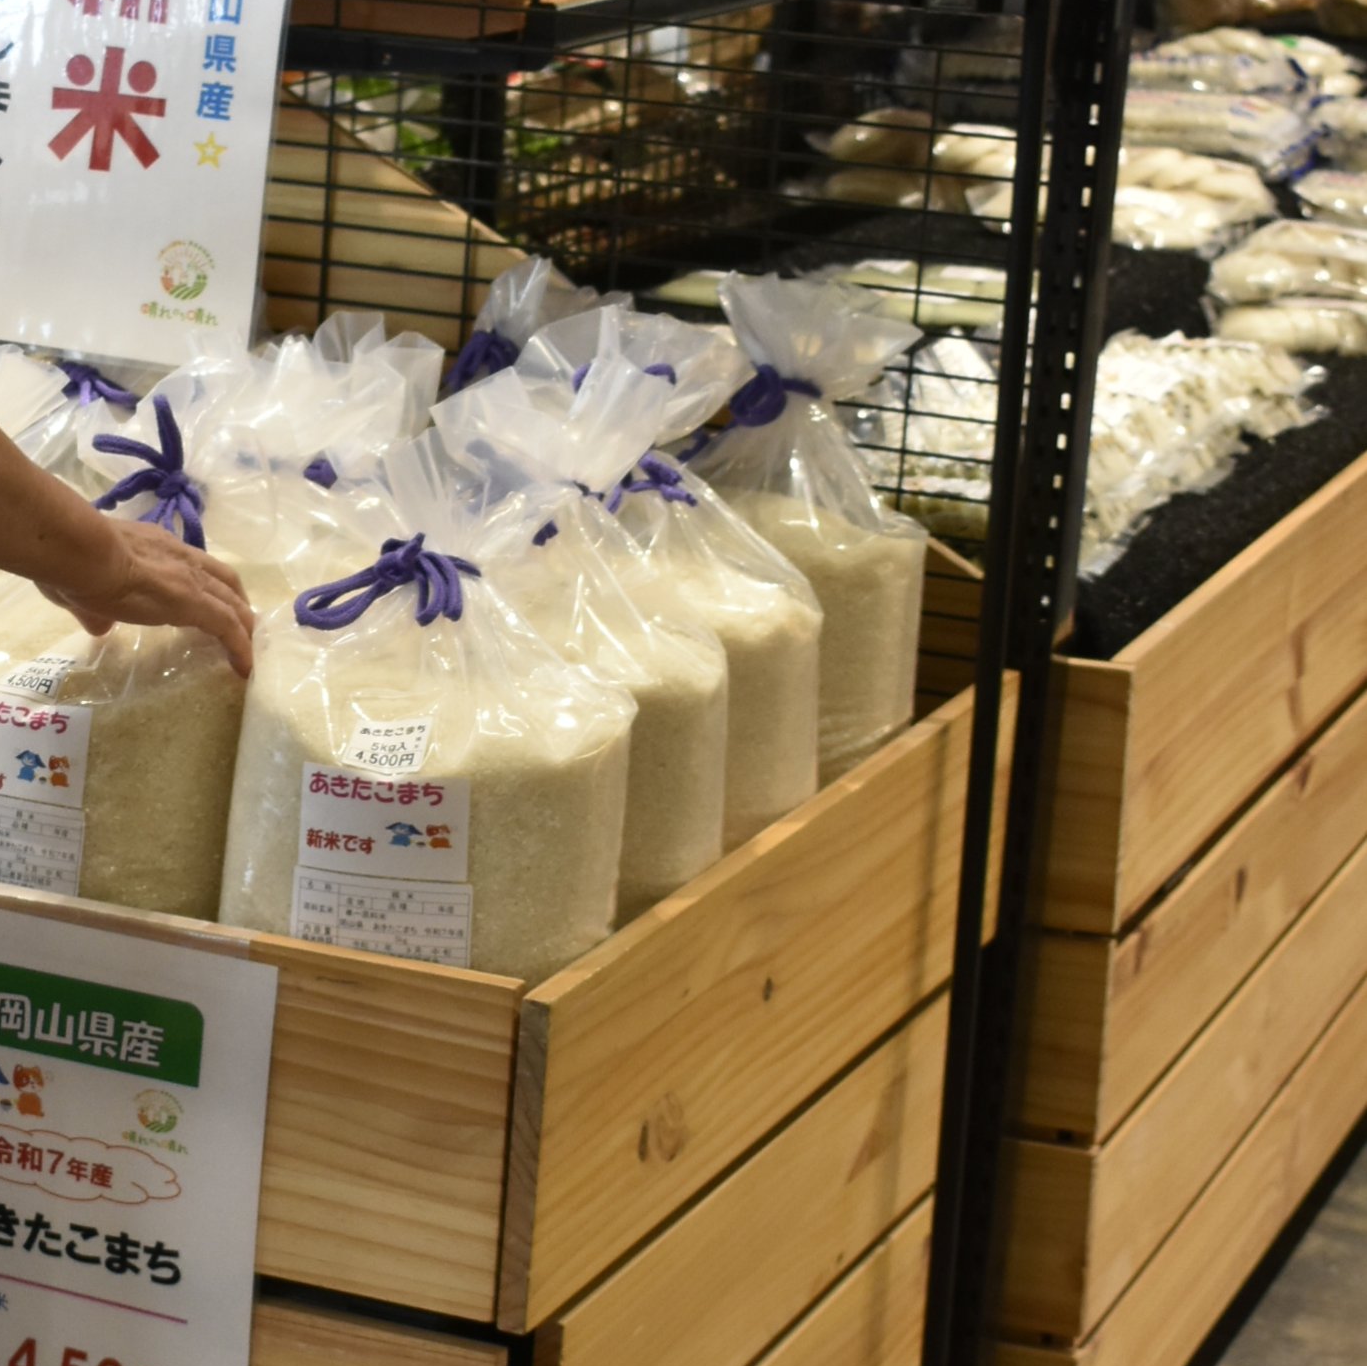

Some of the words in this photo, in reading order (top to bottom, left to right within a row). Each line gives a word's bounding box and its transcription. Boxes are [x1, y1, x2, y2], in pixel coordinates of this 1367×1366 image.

[7, 674, 54, 694] 4,500円
[360, 725, 426, 737] あきたこまち
[355, 750, 415, 767] 4,500円
[309, 771, 445, 806] あきたこまち
[306, 828, 376, 855] 新米です
